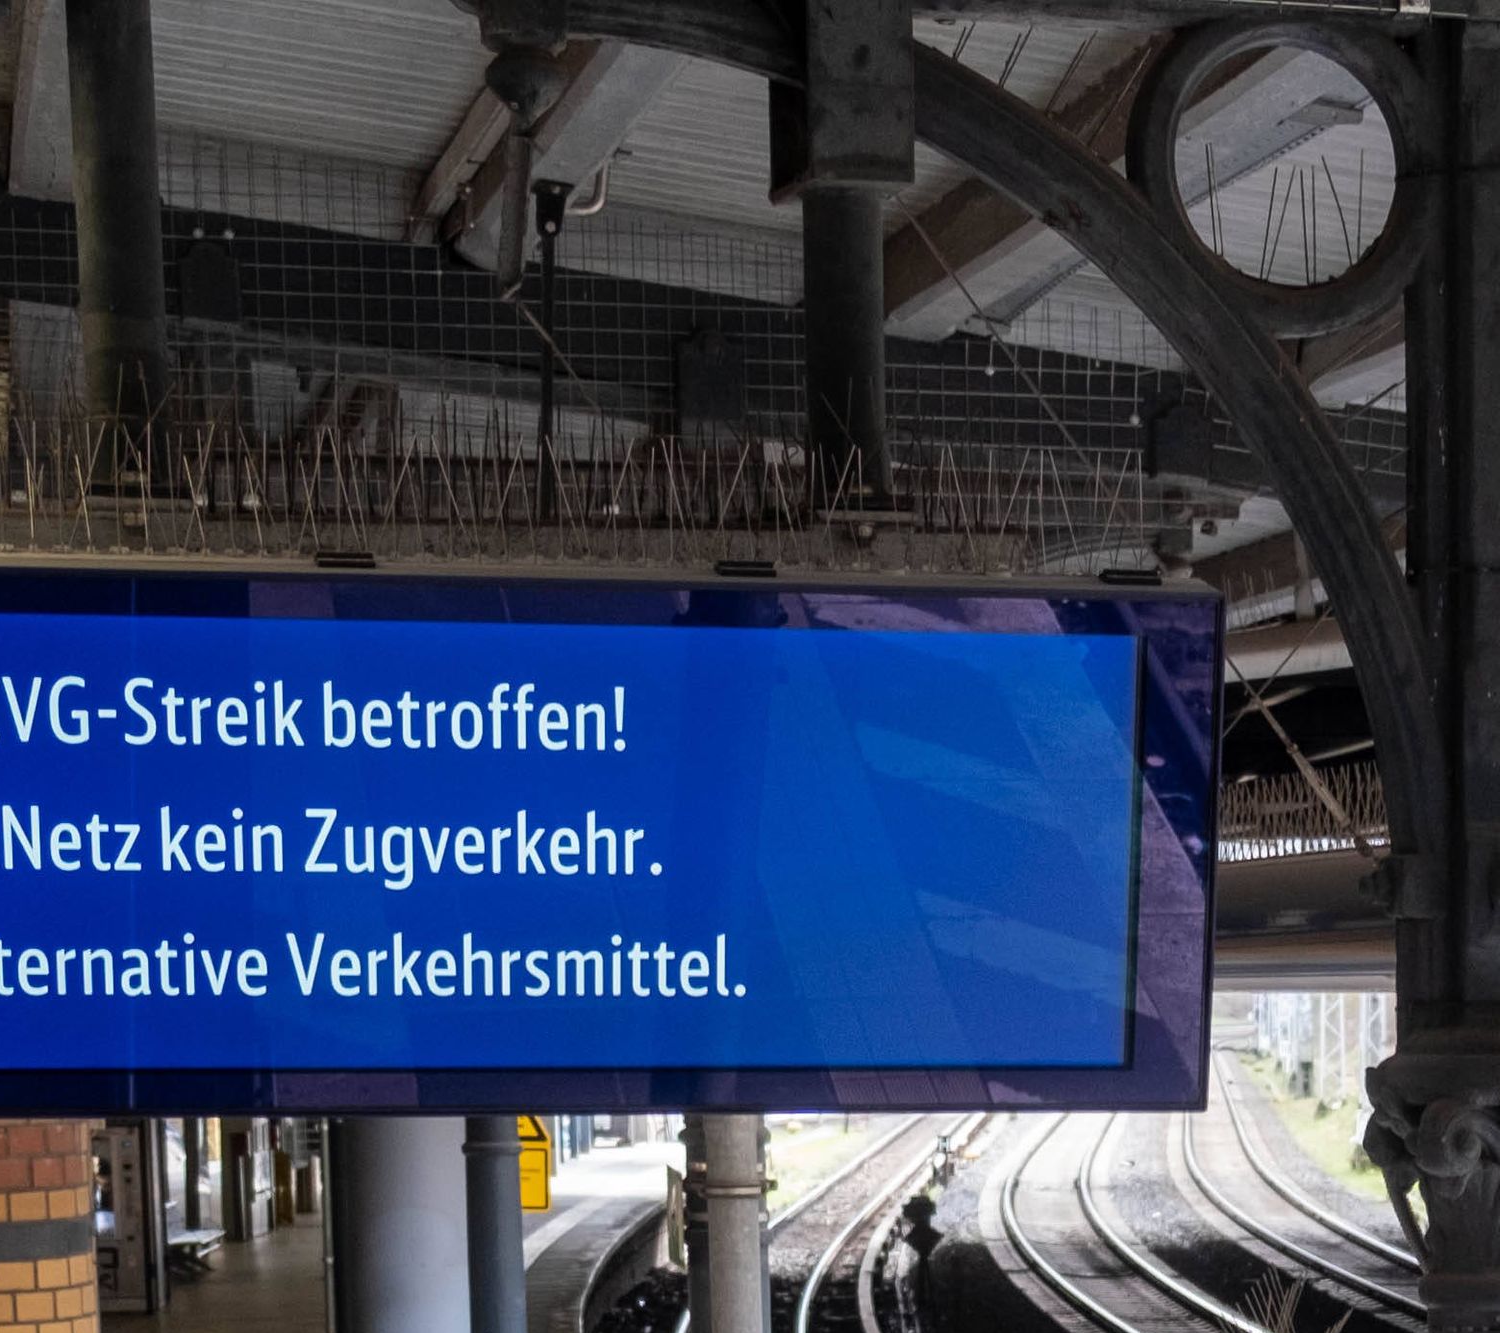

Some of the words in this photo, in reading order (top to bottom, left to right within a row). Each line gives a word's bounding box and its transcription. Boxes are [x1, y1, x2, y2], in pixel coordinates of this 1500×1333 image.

[324, 681, 626, 751] betroffen!
[3, 806, 141, 871] Netz
[161, 806, 283, 871] kein
[305, 809, 663, 890] Zugverkehr.
[287, 932, 746, 996] Verkehrsmittel.
